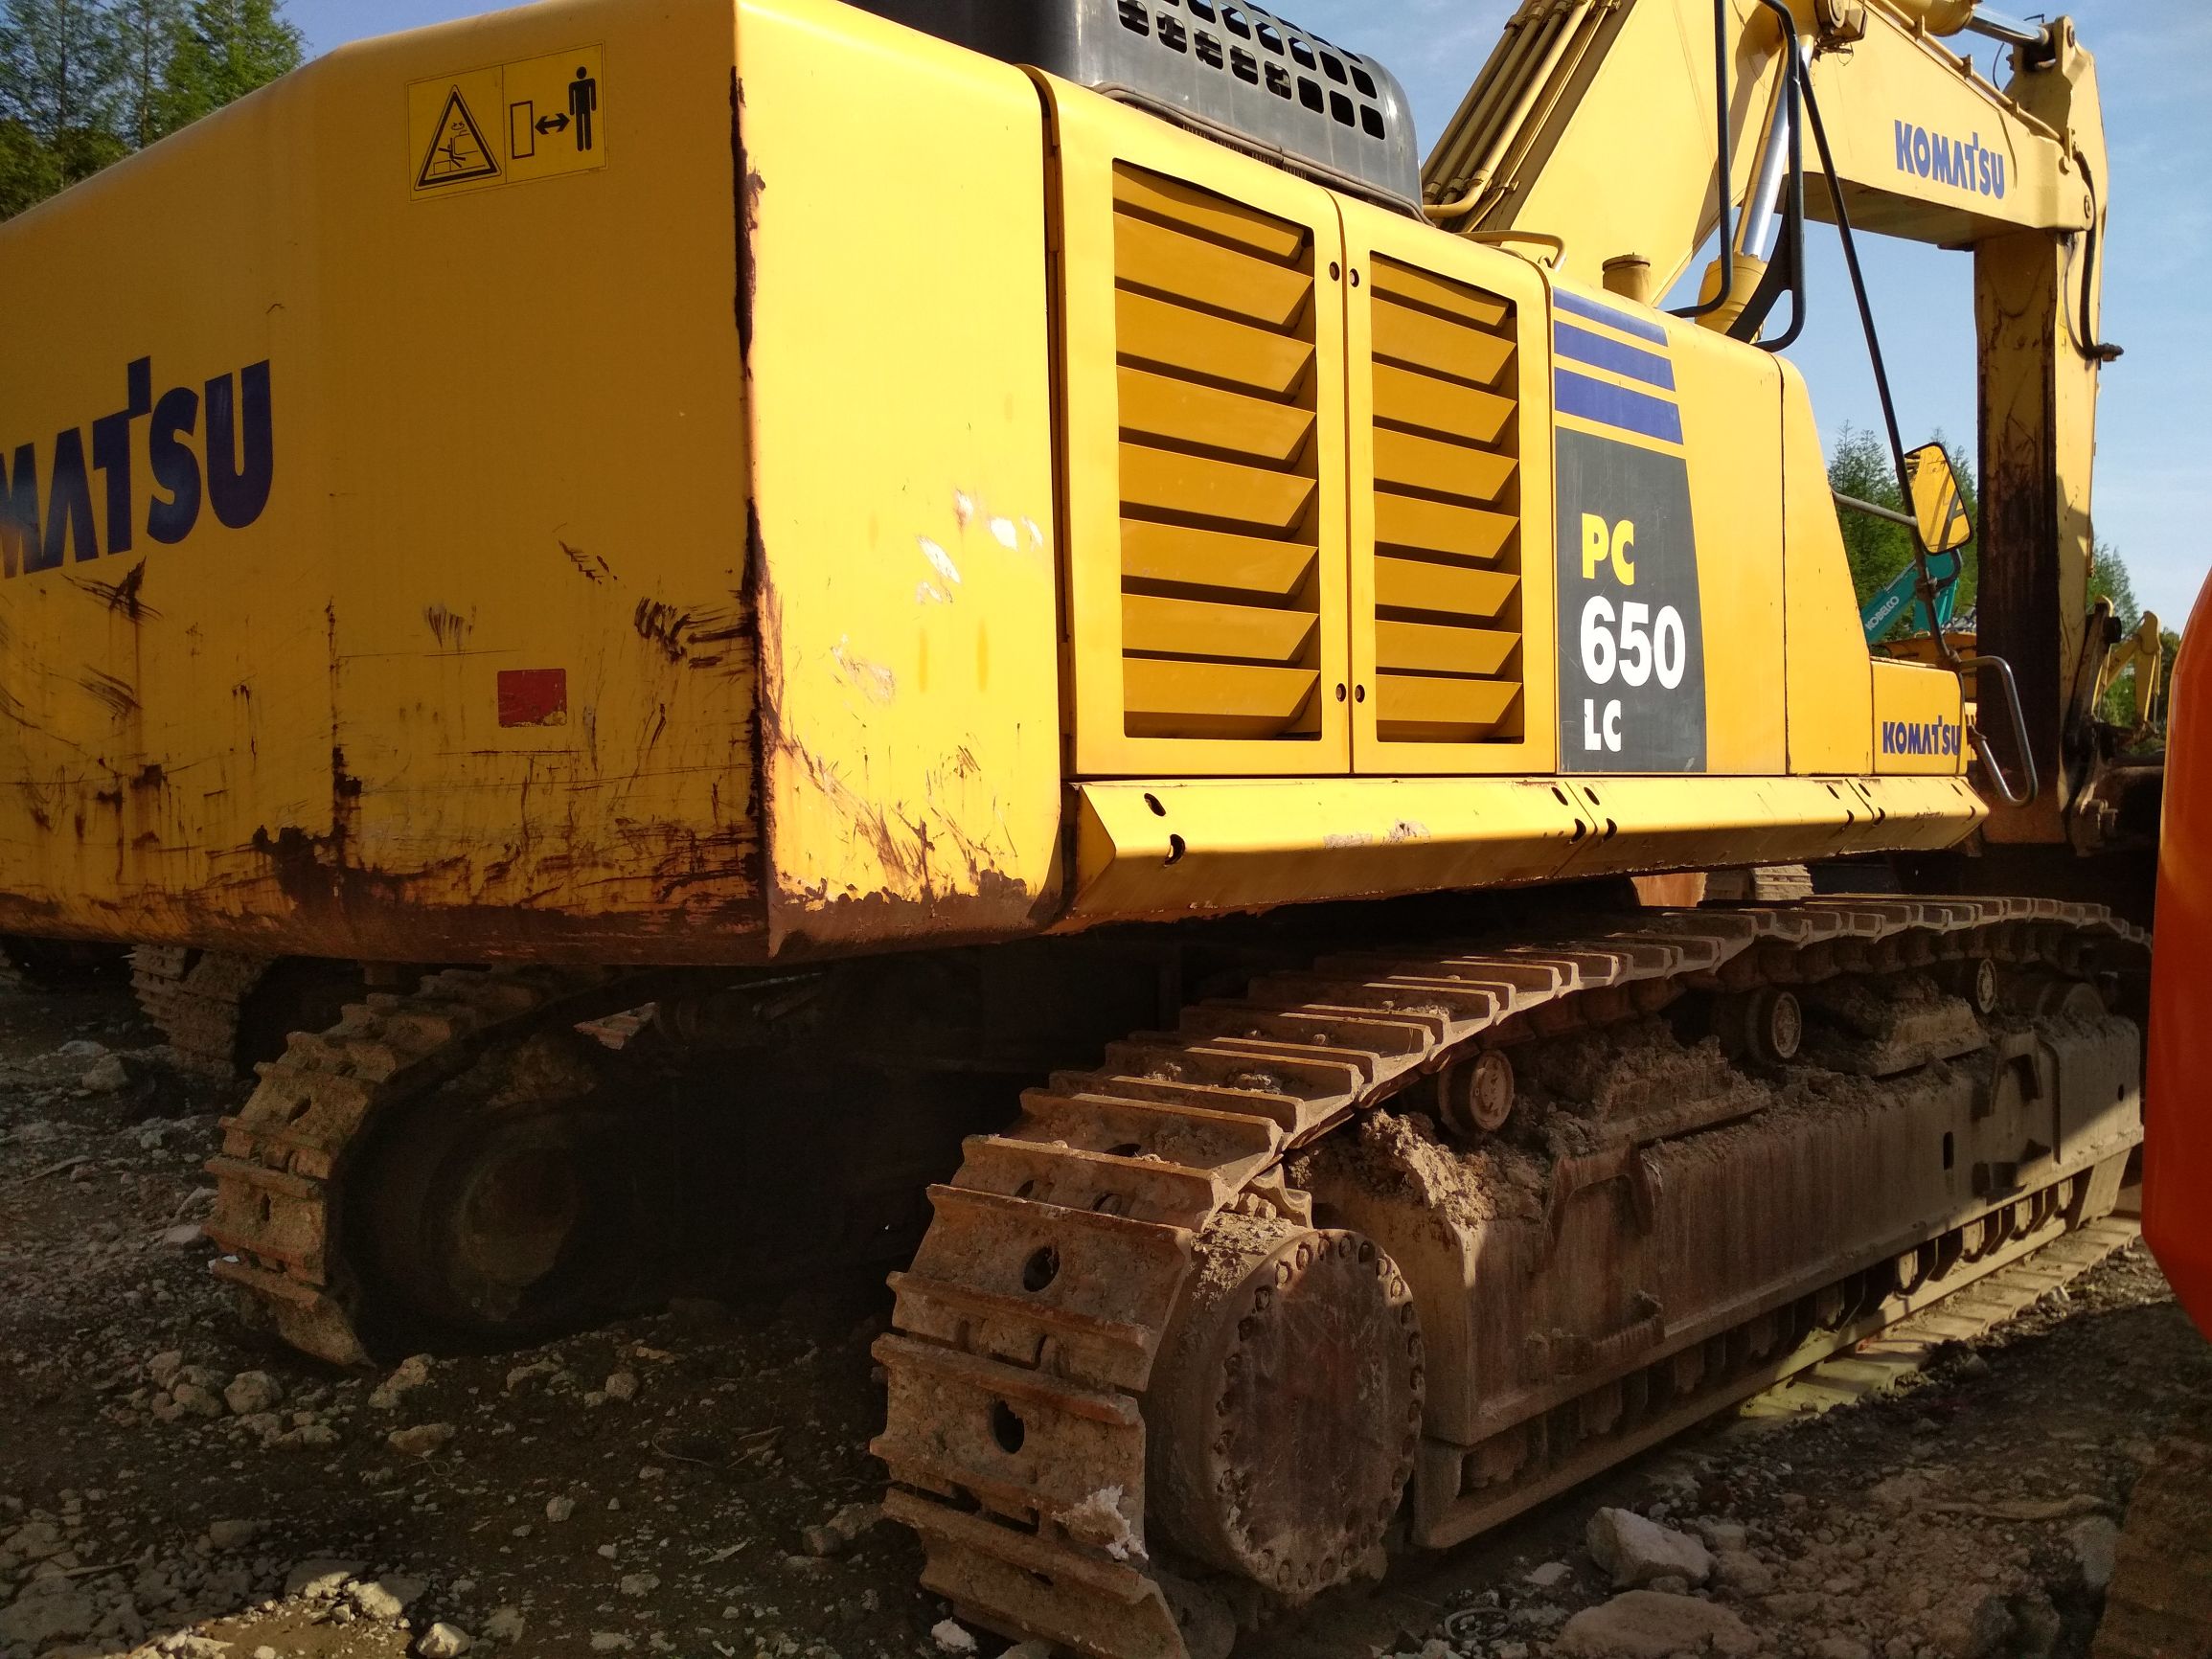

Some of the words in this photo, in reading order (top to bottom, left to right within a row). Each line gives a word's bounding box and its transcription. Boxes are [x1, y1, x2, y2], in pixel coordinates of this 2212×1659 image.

[1894, 119, 2004, 199] KOMATSU
[1582, 512, 1634, 585] PC
[1581, 595, 1686, 690] 650
[1864, 596, 1900, 631] KOBELCO
[1584, 698, 1622, 752] LC
[1882, 715, 1961, 756] KOMATSU
